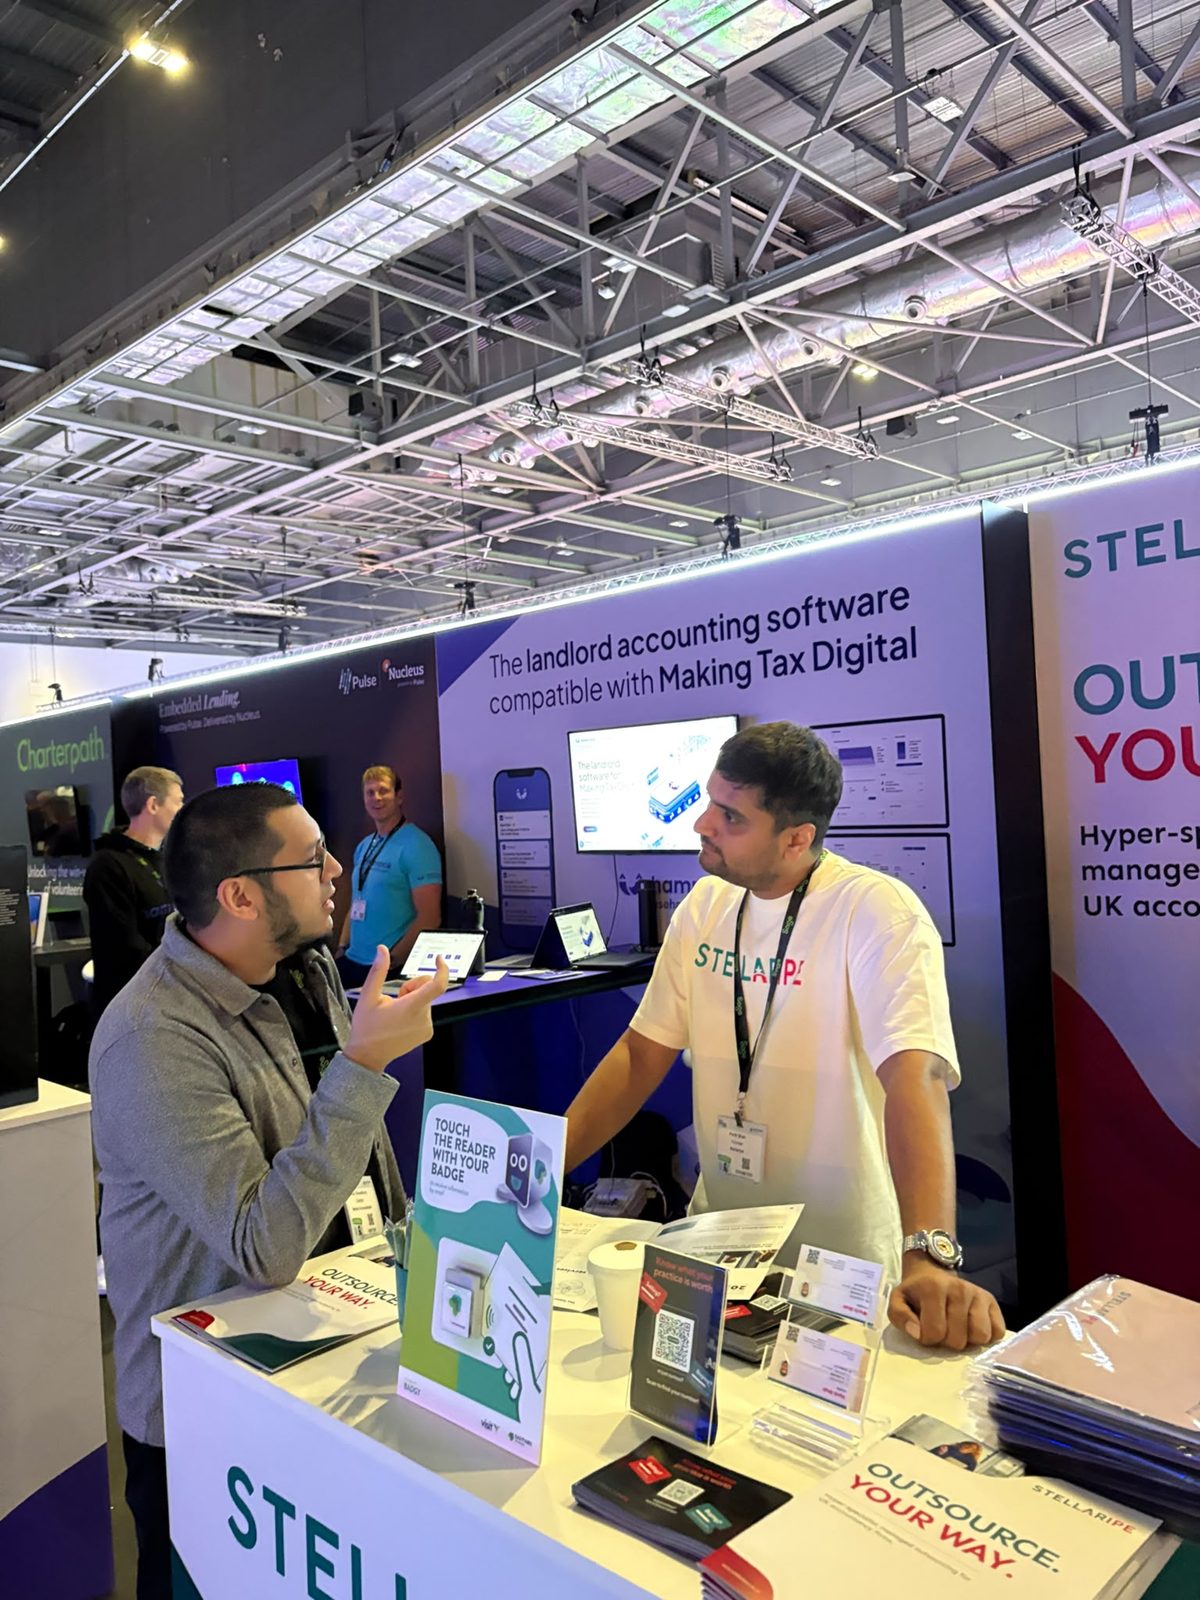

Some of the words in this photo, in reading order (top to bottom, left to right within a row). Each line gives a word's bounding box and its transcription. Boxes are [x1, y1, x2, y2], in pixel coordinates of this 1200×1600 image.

[489, 654, 523, 678] The
[526, 634, 612, 673] landlord
[617, 613, 760, 658] accounting
[767, 586, 910, 632] software
[351, 674, 378, 691] Pulse
[388, 664, 425, 681] Nucleus
[489, 677, 603, 715] compatible
[606, 668, 654, 699] with
[658, 658, 752, 692] Making
[756, 648, 806, 679] Tax
[812, 626, 917, 675] Digital
[159, 695, 202, 718] Embedded
[203, 689, 241, 709] Lending
[17, 725, 104, 774] Charterpath
[1080, 825, 1200, 852] Hyper-s
[1084, 895, 1124, 916] UK
[435, 1117, 471, 1138] TOUCH
[434, 1132, 453, 1151] THE
[455, 1138, 496, 1160] READER
[431, 1162, 465, 1183] BADGE
[433, 1147, 458, 1165] WITH
[460, 1153, 489, 1174] YOUR
[303, 1275, 343, 1296] YOUR
[339, 1291, 375, 1309] WAY.
[653, 1268, 683, 1285] practice
[690, 1279, 714, 1295] worth
[867, 1463, 1061, 1573] OUTSOURCE.
[1032, 1484, 1137, 1534] STELLARIPE
[227, 1466, 407, 1600] STE
[850, 1474, 935, 1530] YOUR
[939, 1523, 1016, 1579] WAY.
